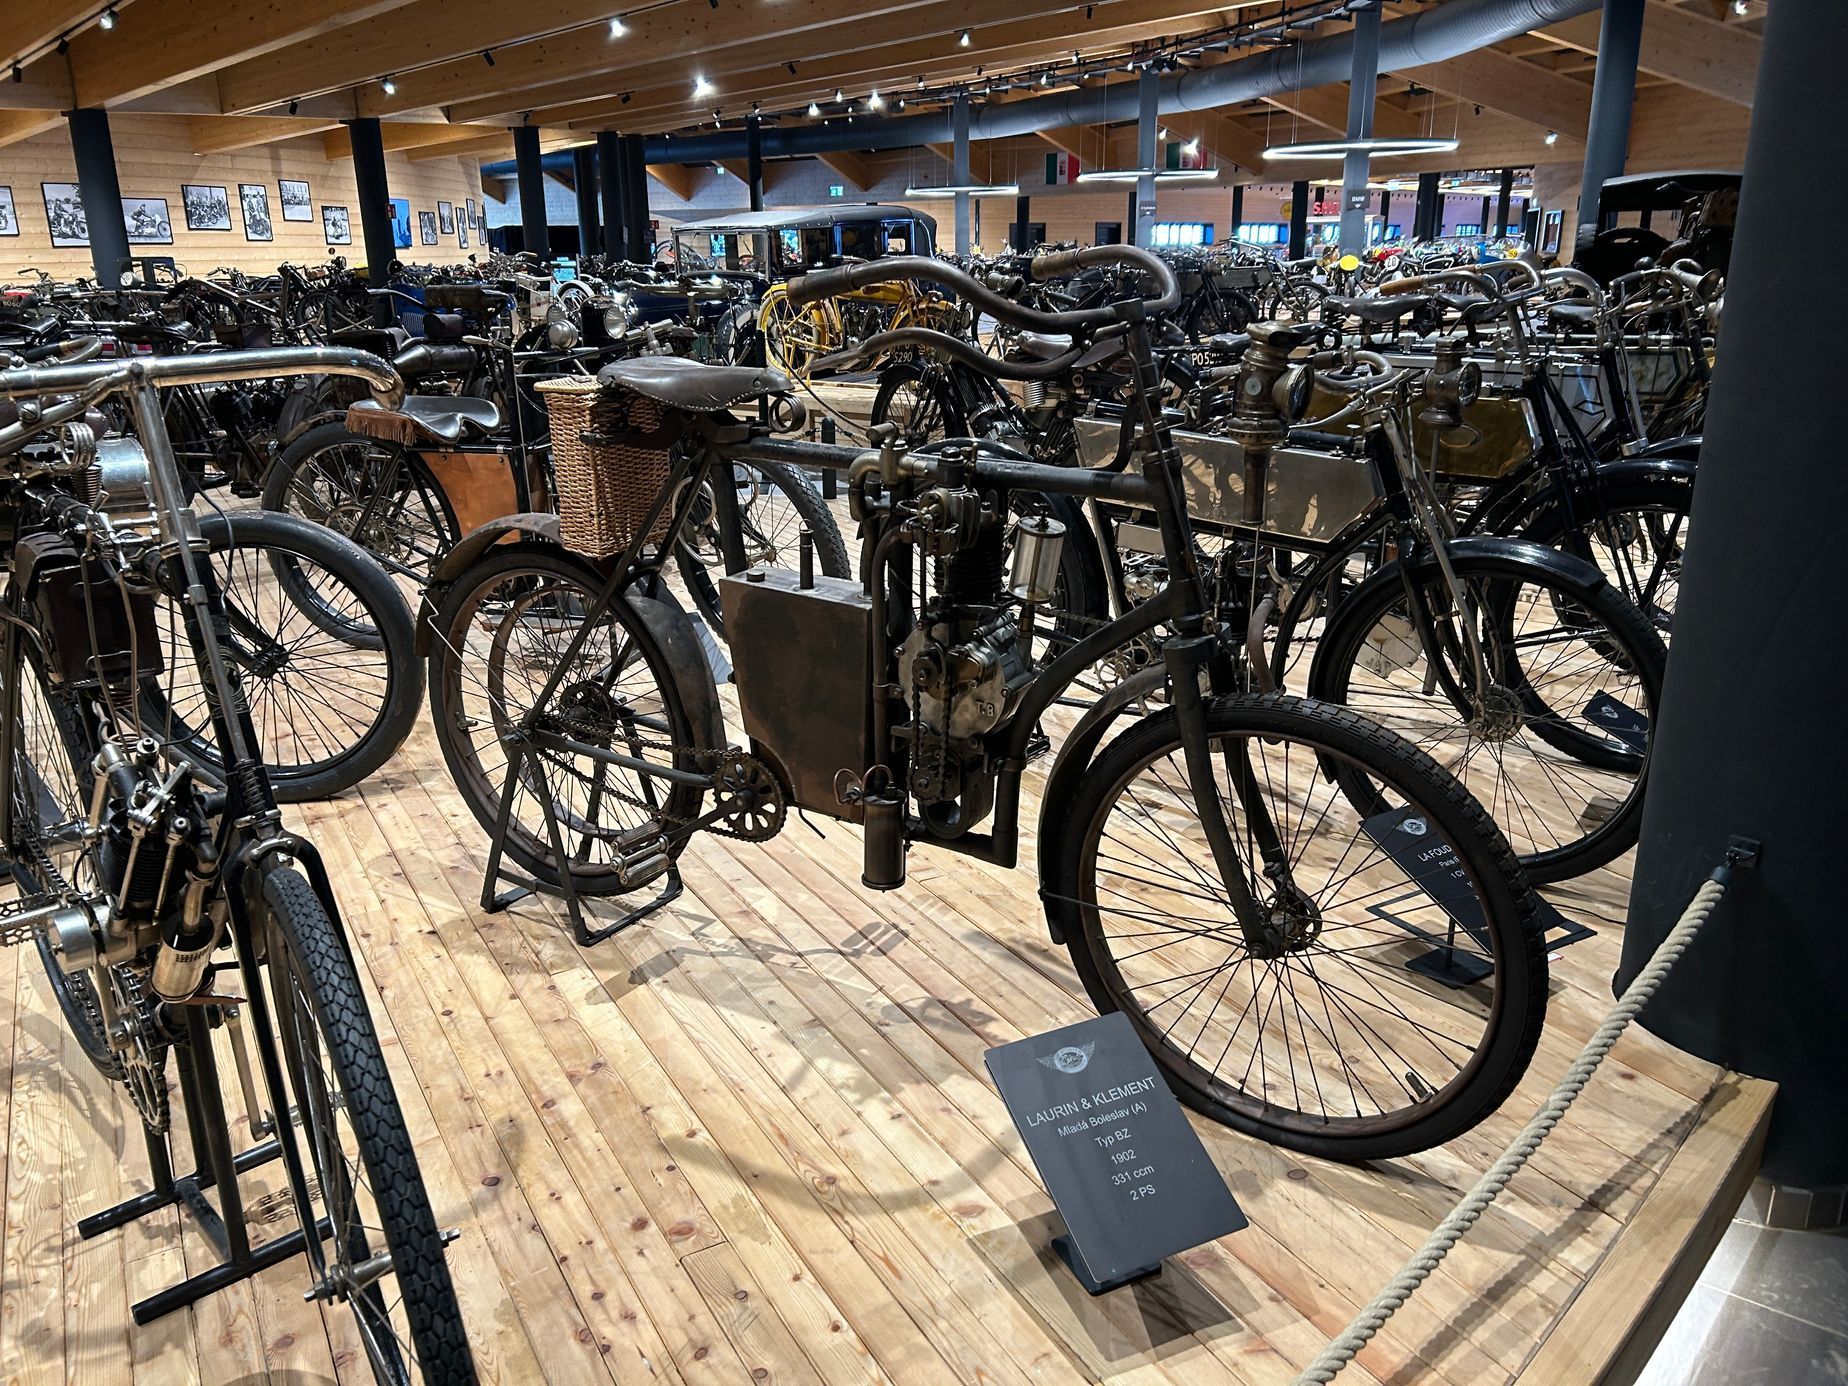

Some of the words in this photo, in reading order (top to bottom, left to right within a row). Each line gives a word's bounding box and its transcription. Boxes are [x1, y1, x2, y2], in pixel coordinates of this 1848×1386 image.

[894, 351, 913, 363] 5290
[1026, 1101, 1080, 1127] LAURIN
[1080, 1097, 1093, 1110] &
[1092, 1076, 1156, 1106] KLEMENT
[1057, 1120, 1090, 1137] Mladá
[1088, 1107, 1130, 1127] Boleslav
[1130, 1101, 1147, 1116] (A)
[1094, 1136, 1115, 1148] Typ
[1114, 1128, 1132, 1141] BZ
[1111, 1149, 1137, 1165] 1902
[1111, 1171, 1132, 1186] 331
[1133, 1165, 1155, 1178] ccm
[1129, 1190, 1139, 1201] 2
[1138, 1184, 1156, 1197] PS
